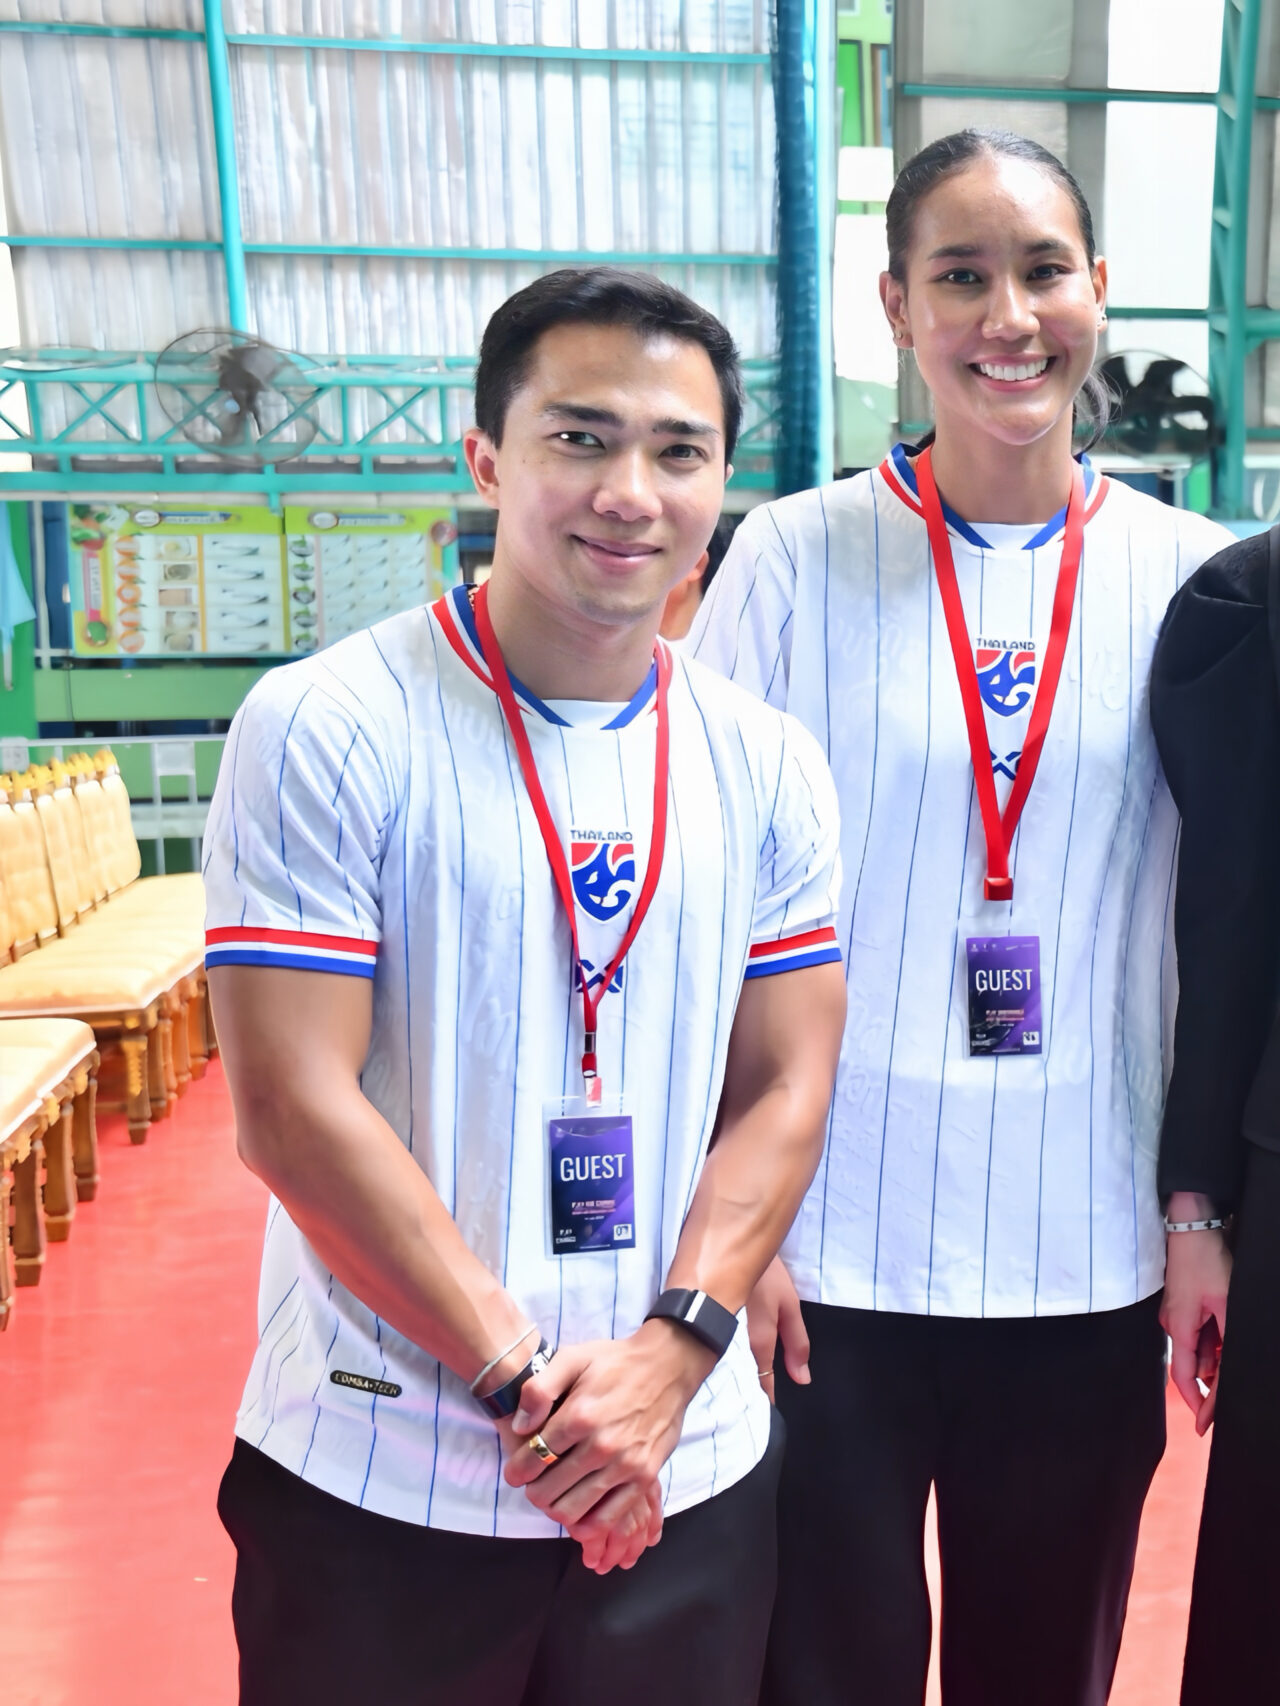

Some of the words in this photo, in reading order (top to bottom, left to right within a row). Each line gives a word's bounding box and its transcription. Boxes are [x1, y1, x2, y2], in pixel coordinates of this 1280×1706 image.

[976, 637, 1036, 650] THAILAND
[570, 829, 633, 841] THAILAND
[975, 969, 1033, 992] GUEST
[560, 1153, 627, 1182] GUEST
